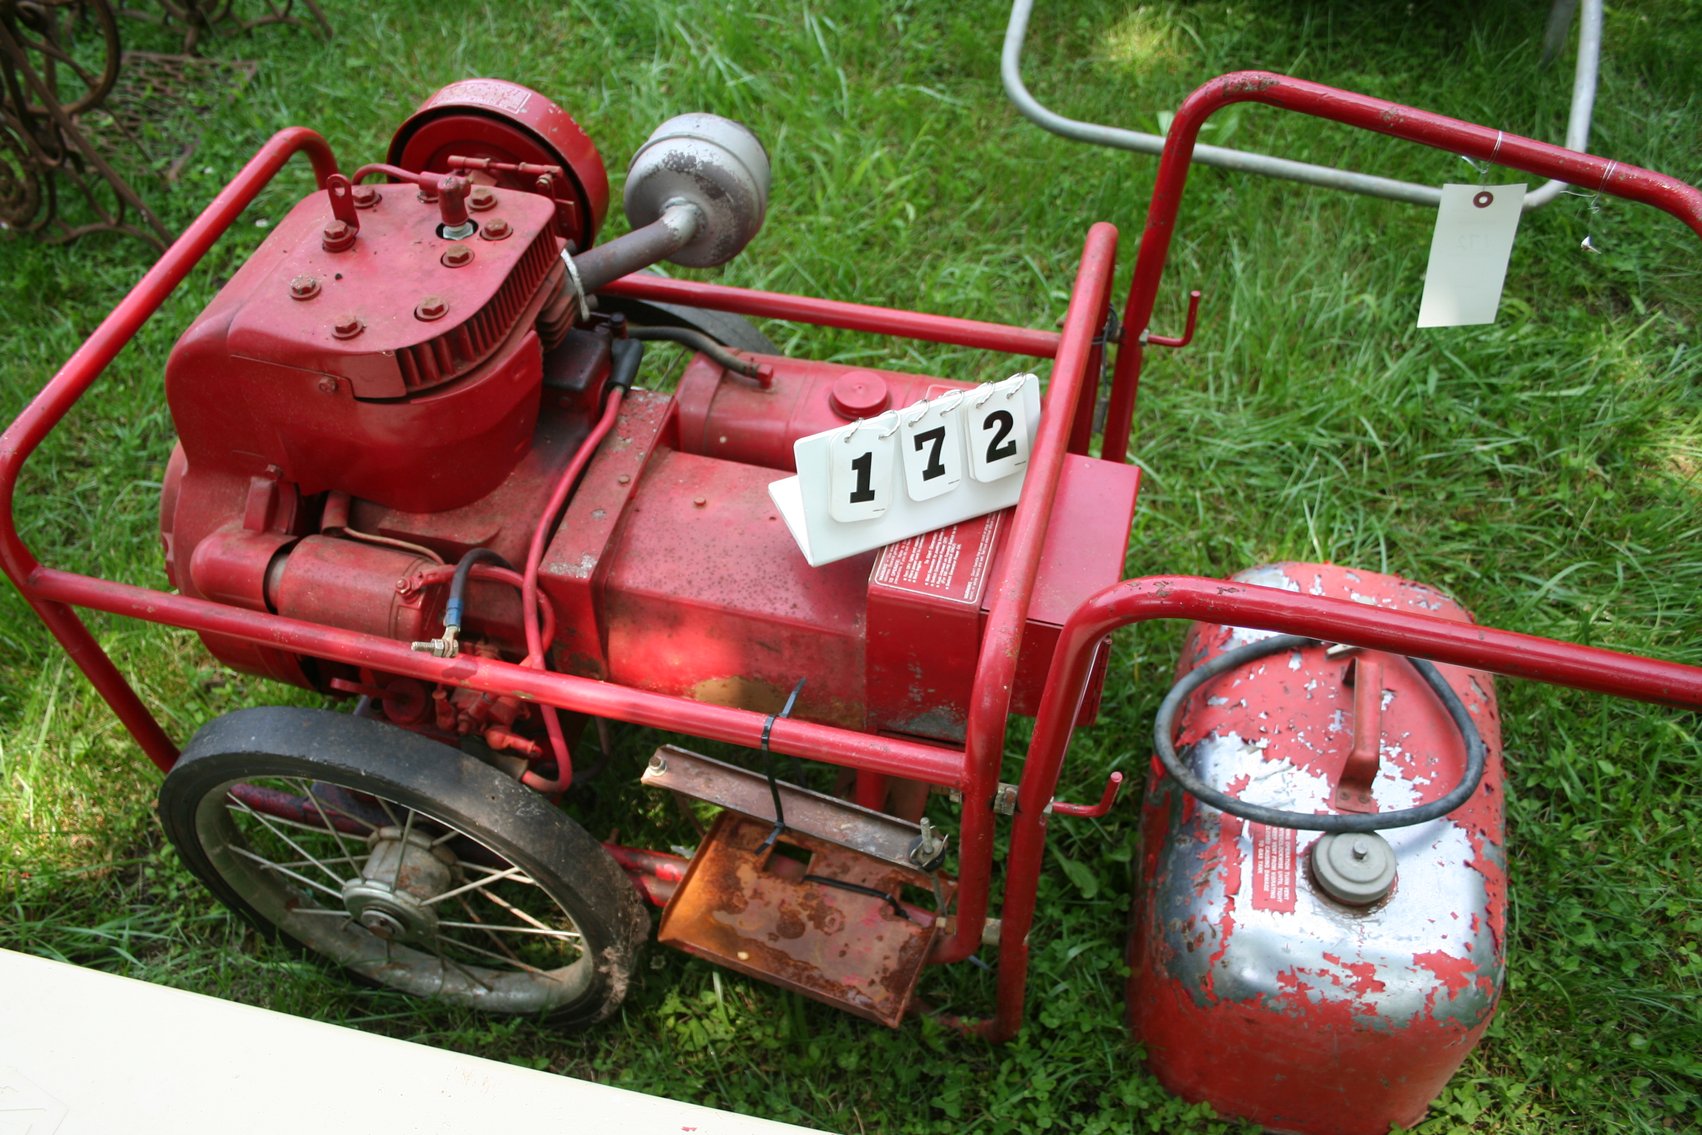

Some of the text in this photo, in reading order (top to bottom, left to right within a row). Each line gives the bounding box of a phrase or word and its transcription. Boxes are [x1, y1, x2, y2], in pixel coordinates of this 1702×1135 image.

[850, 410, 1017, 504] 1 7 2
